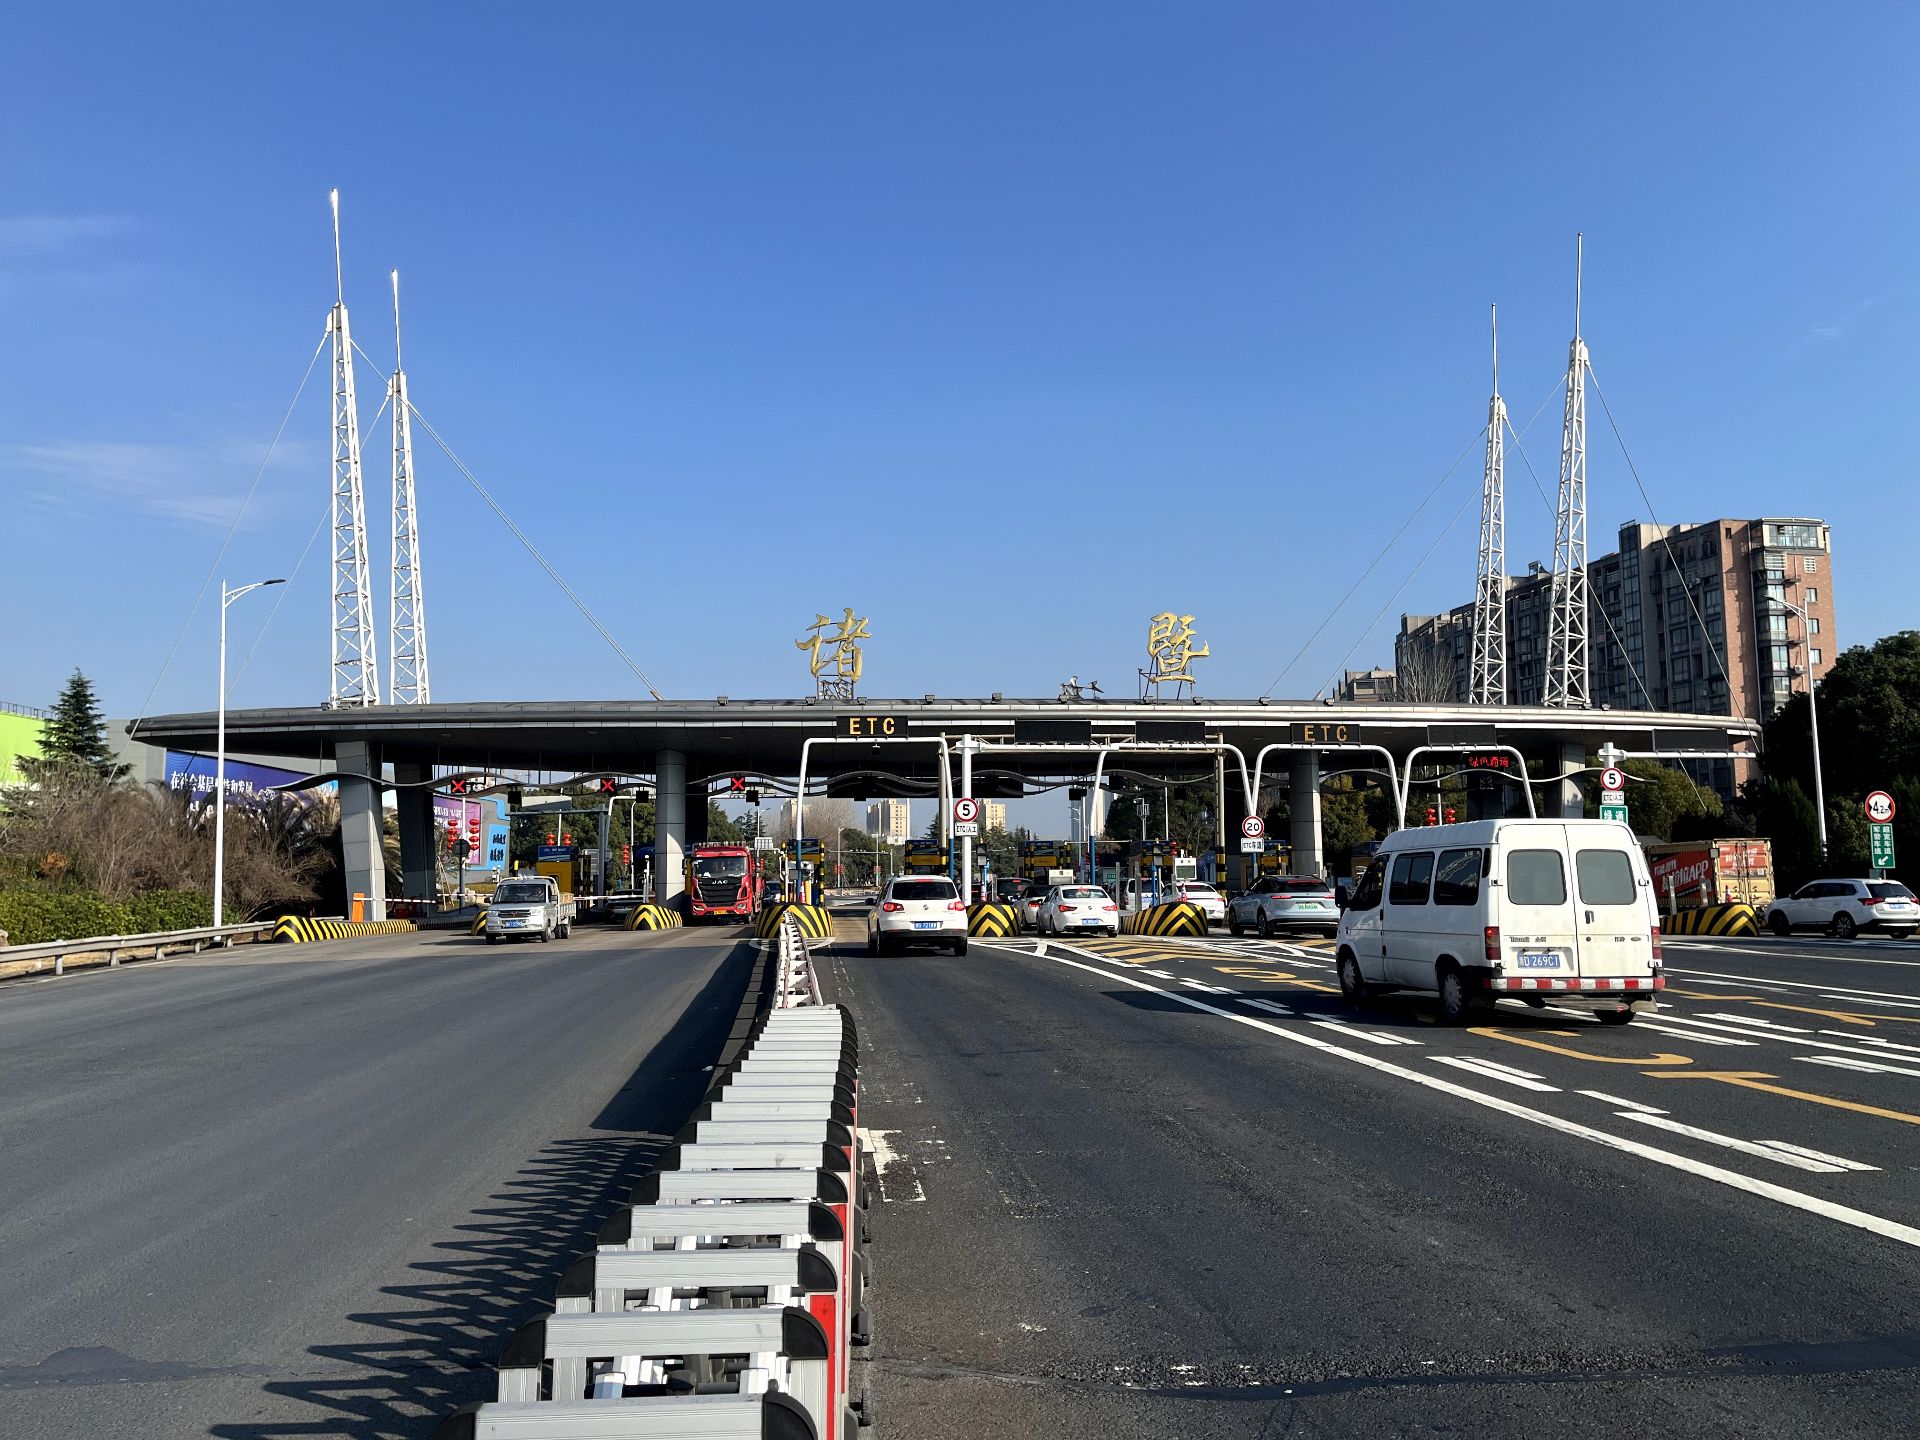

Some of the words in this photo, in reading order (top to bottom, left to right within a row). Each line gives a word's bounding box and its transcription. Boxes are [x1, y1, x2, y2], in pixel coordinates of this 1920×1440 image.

[795, 608, 871, 683] 诸
[1147, 611, 1210, 684] 暨
[849, 717, 895, 735] ETC
[1304, 725, 1347, 742] ETC
[1608, 773, 1617, 785] 5
[962, 804, 971, 816] 5
[1247, 822, 1260, 831] 20
